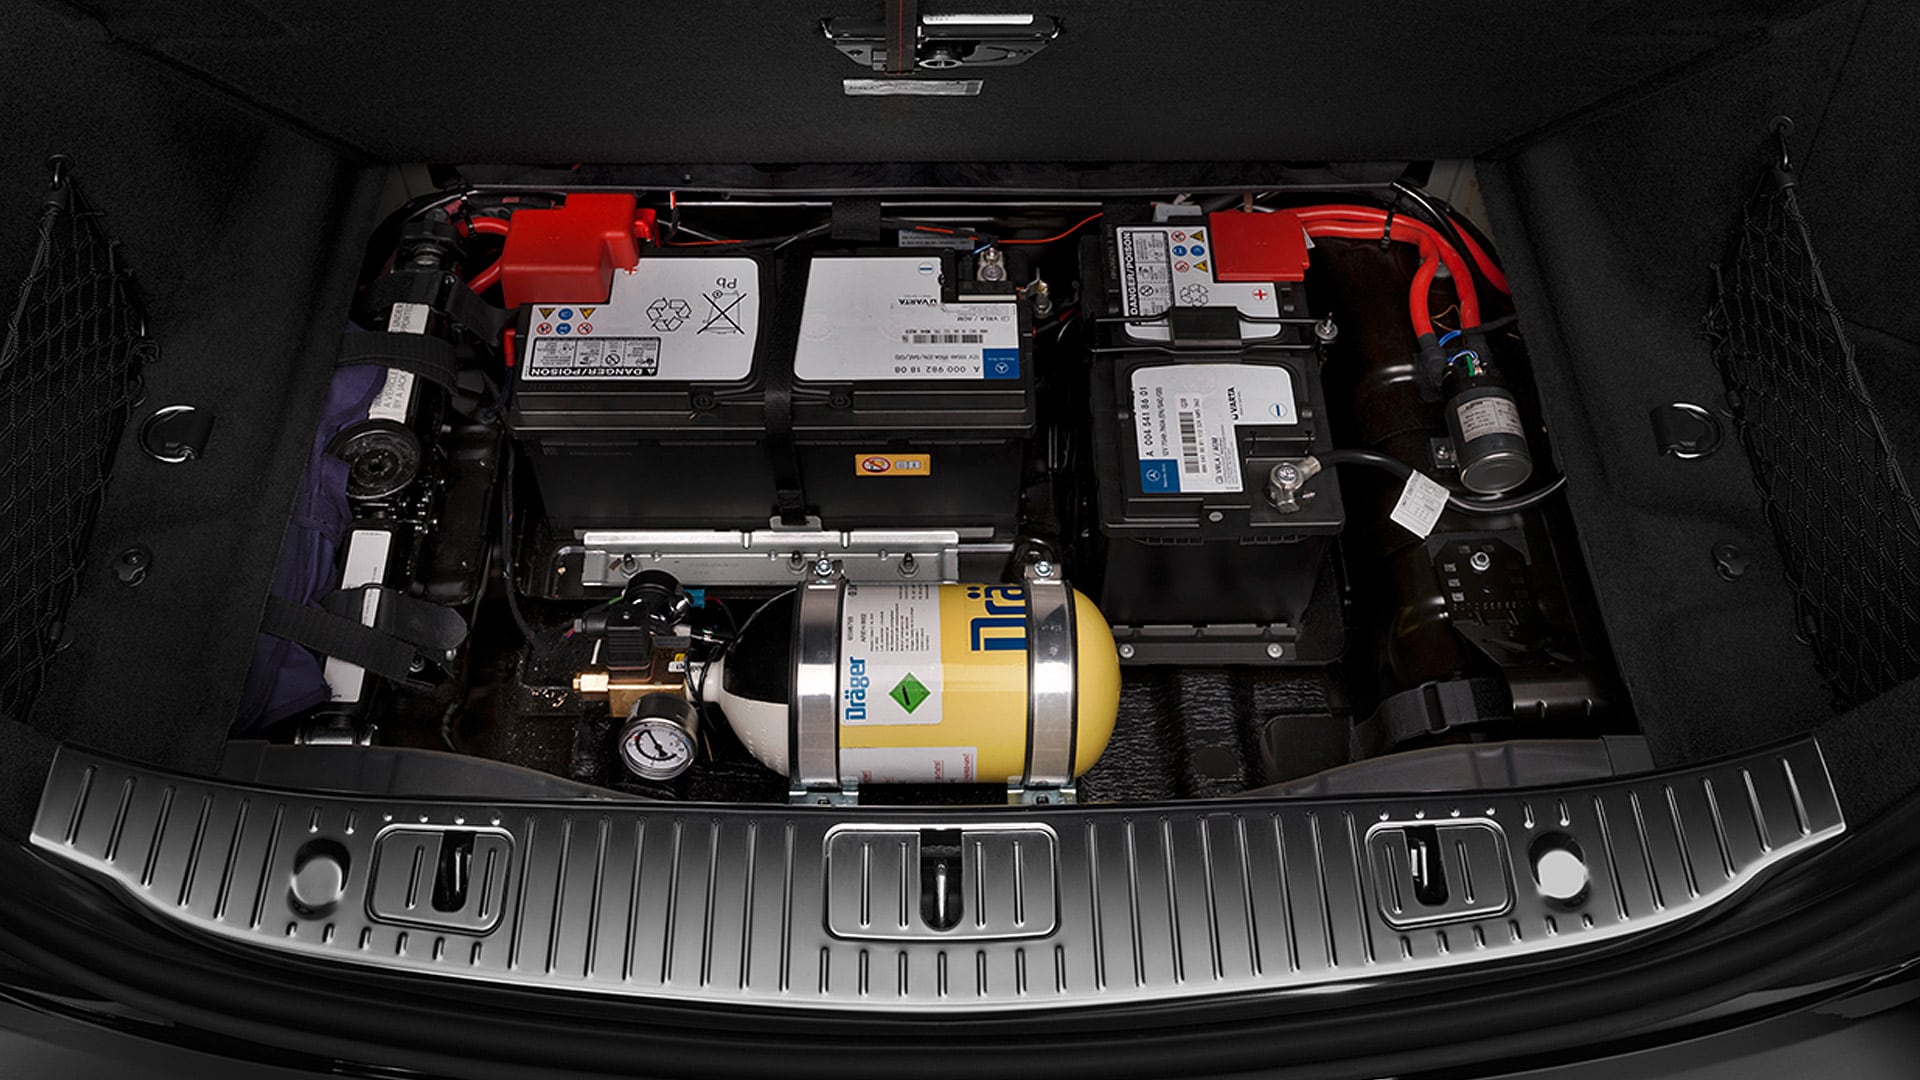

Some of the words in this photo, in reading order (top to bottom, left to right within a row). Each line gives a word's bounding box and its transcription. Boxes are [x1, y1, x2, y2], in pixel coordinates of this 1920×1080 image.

[716, 277, 738, 290] Pb
[1122, 231, 1139, 315] DANGER/POISON
[530, 367, 643, 377] DANGER/POISON
[1227, 386, 1238, 413] VARTA
[844, 656, 869, 720] Dräger
